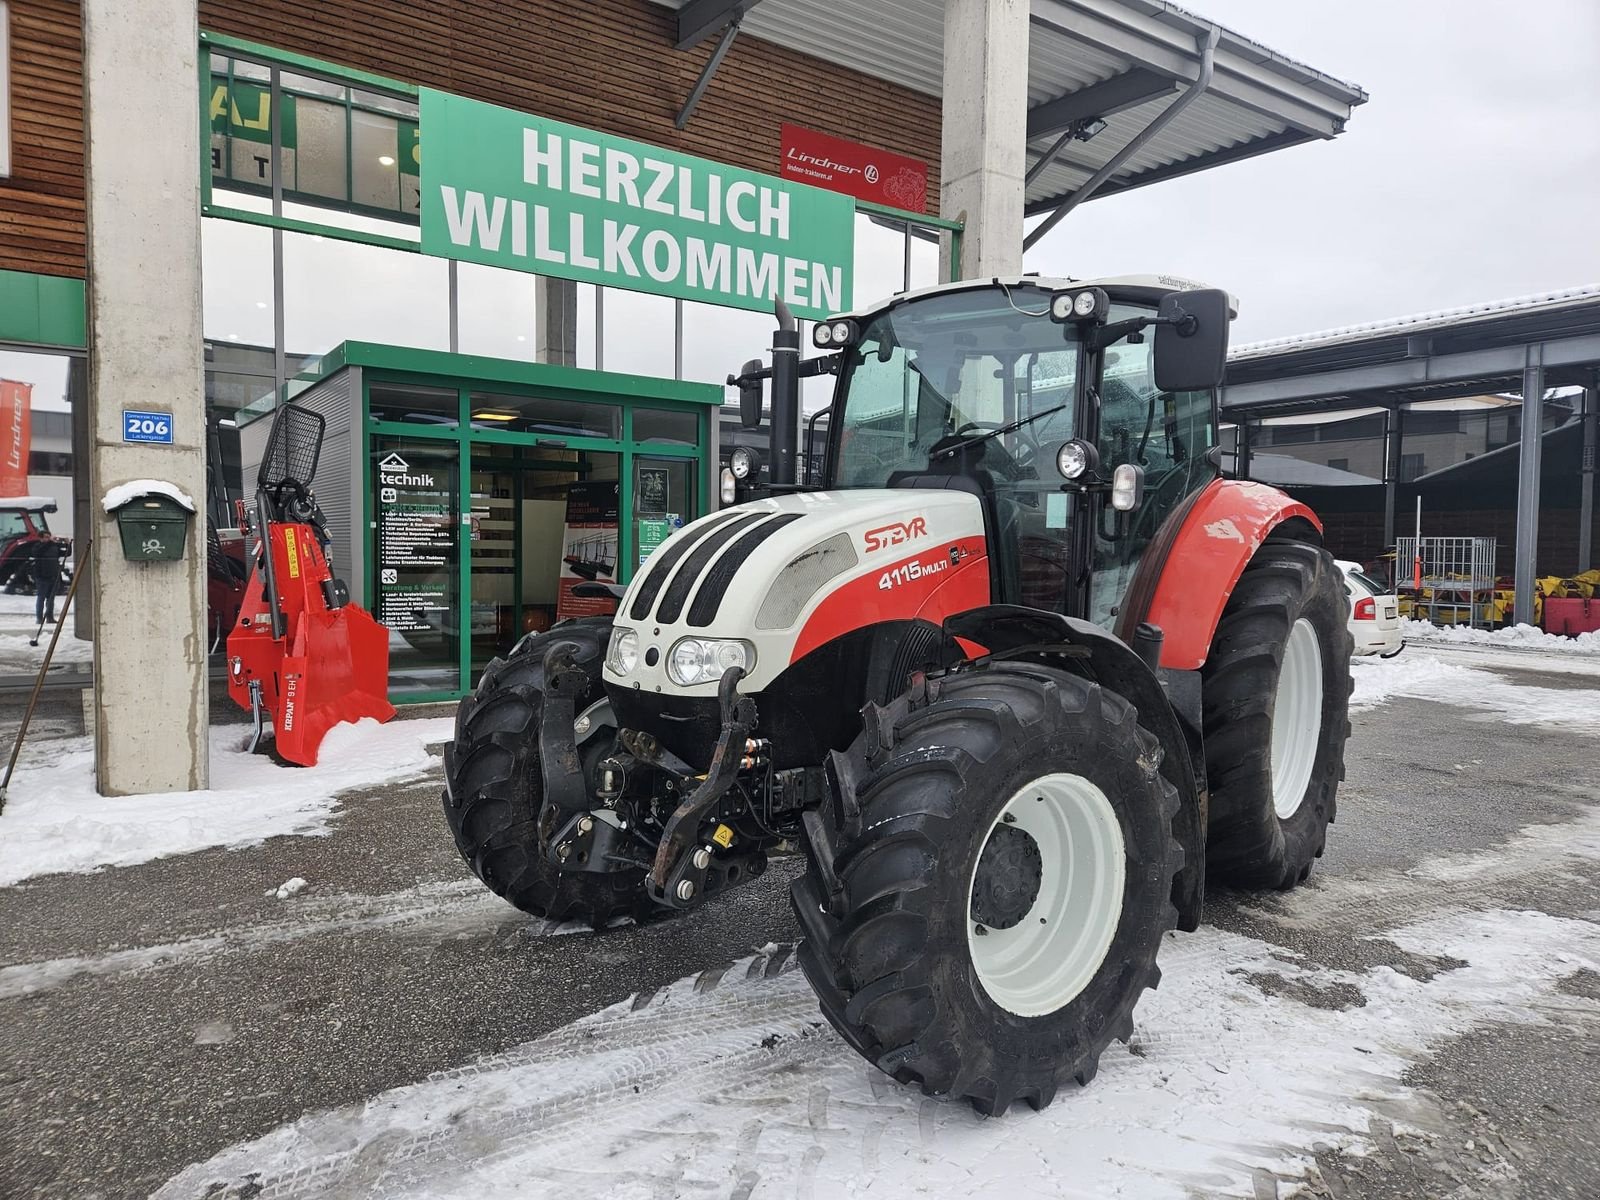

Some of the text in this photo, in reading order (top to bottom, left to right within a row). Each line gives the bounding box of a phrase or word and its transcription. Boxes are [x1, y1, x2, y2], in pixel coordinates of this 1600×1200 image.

[786, 163, 833, 181] lindner-traktoren.at
[787, 147, 861, 174] Lindner
[522, 127, 791, 241] HERZLICH
[440, 184, 843, 313] WILLKOMMEN
[7, 389, 23, 470] Lindner
[128, 420, 168, 435] 206
[380, 472, 434, 487] technik
[865, 517, 927, 553] STEYR
[879, 560, 947, 590] 4115 MULTI
[288, 680, 295, 689] EH
